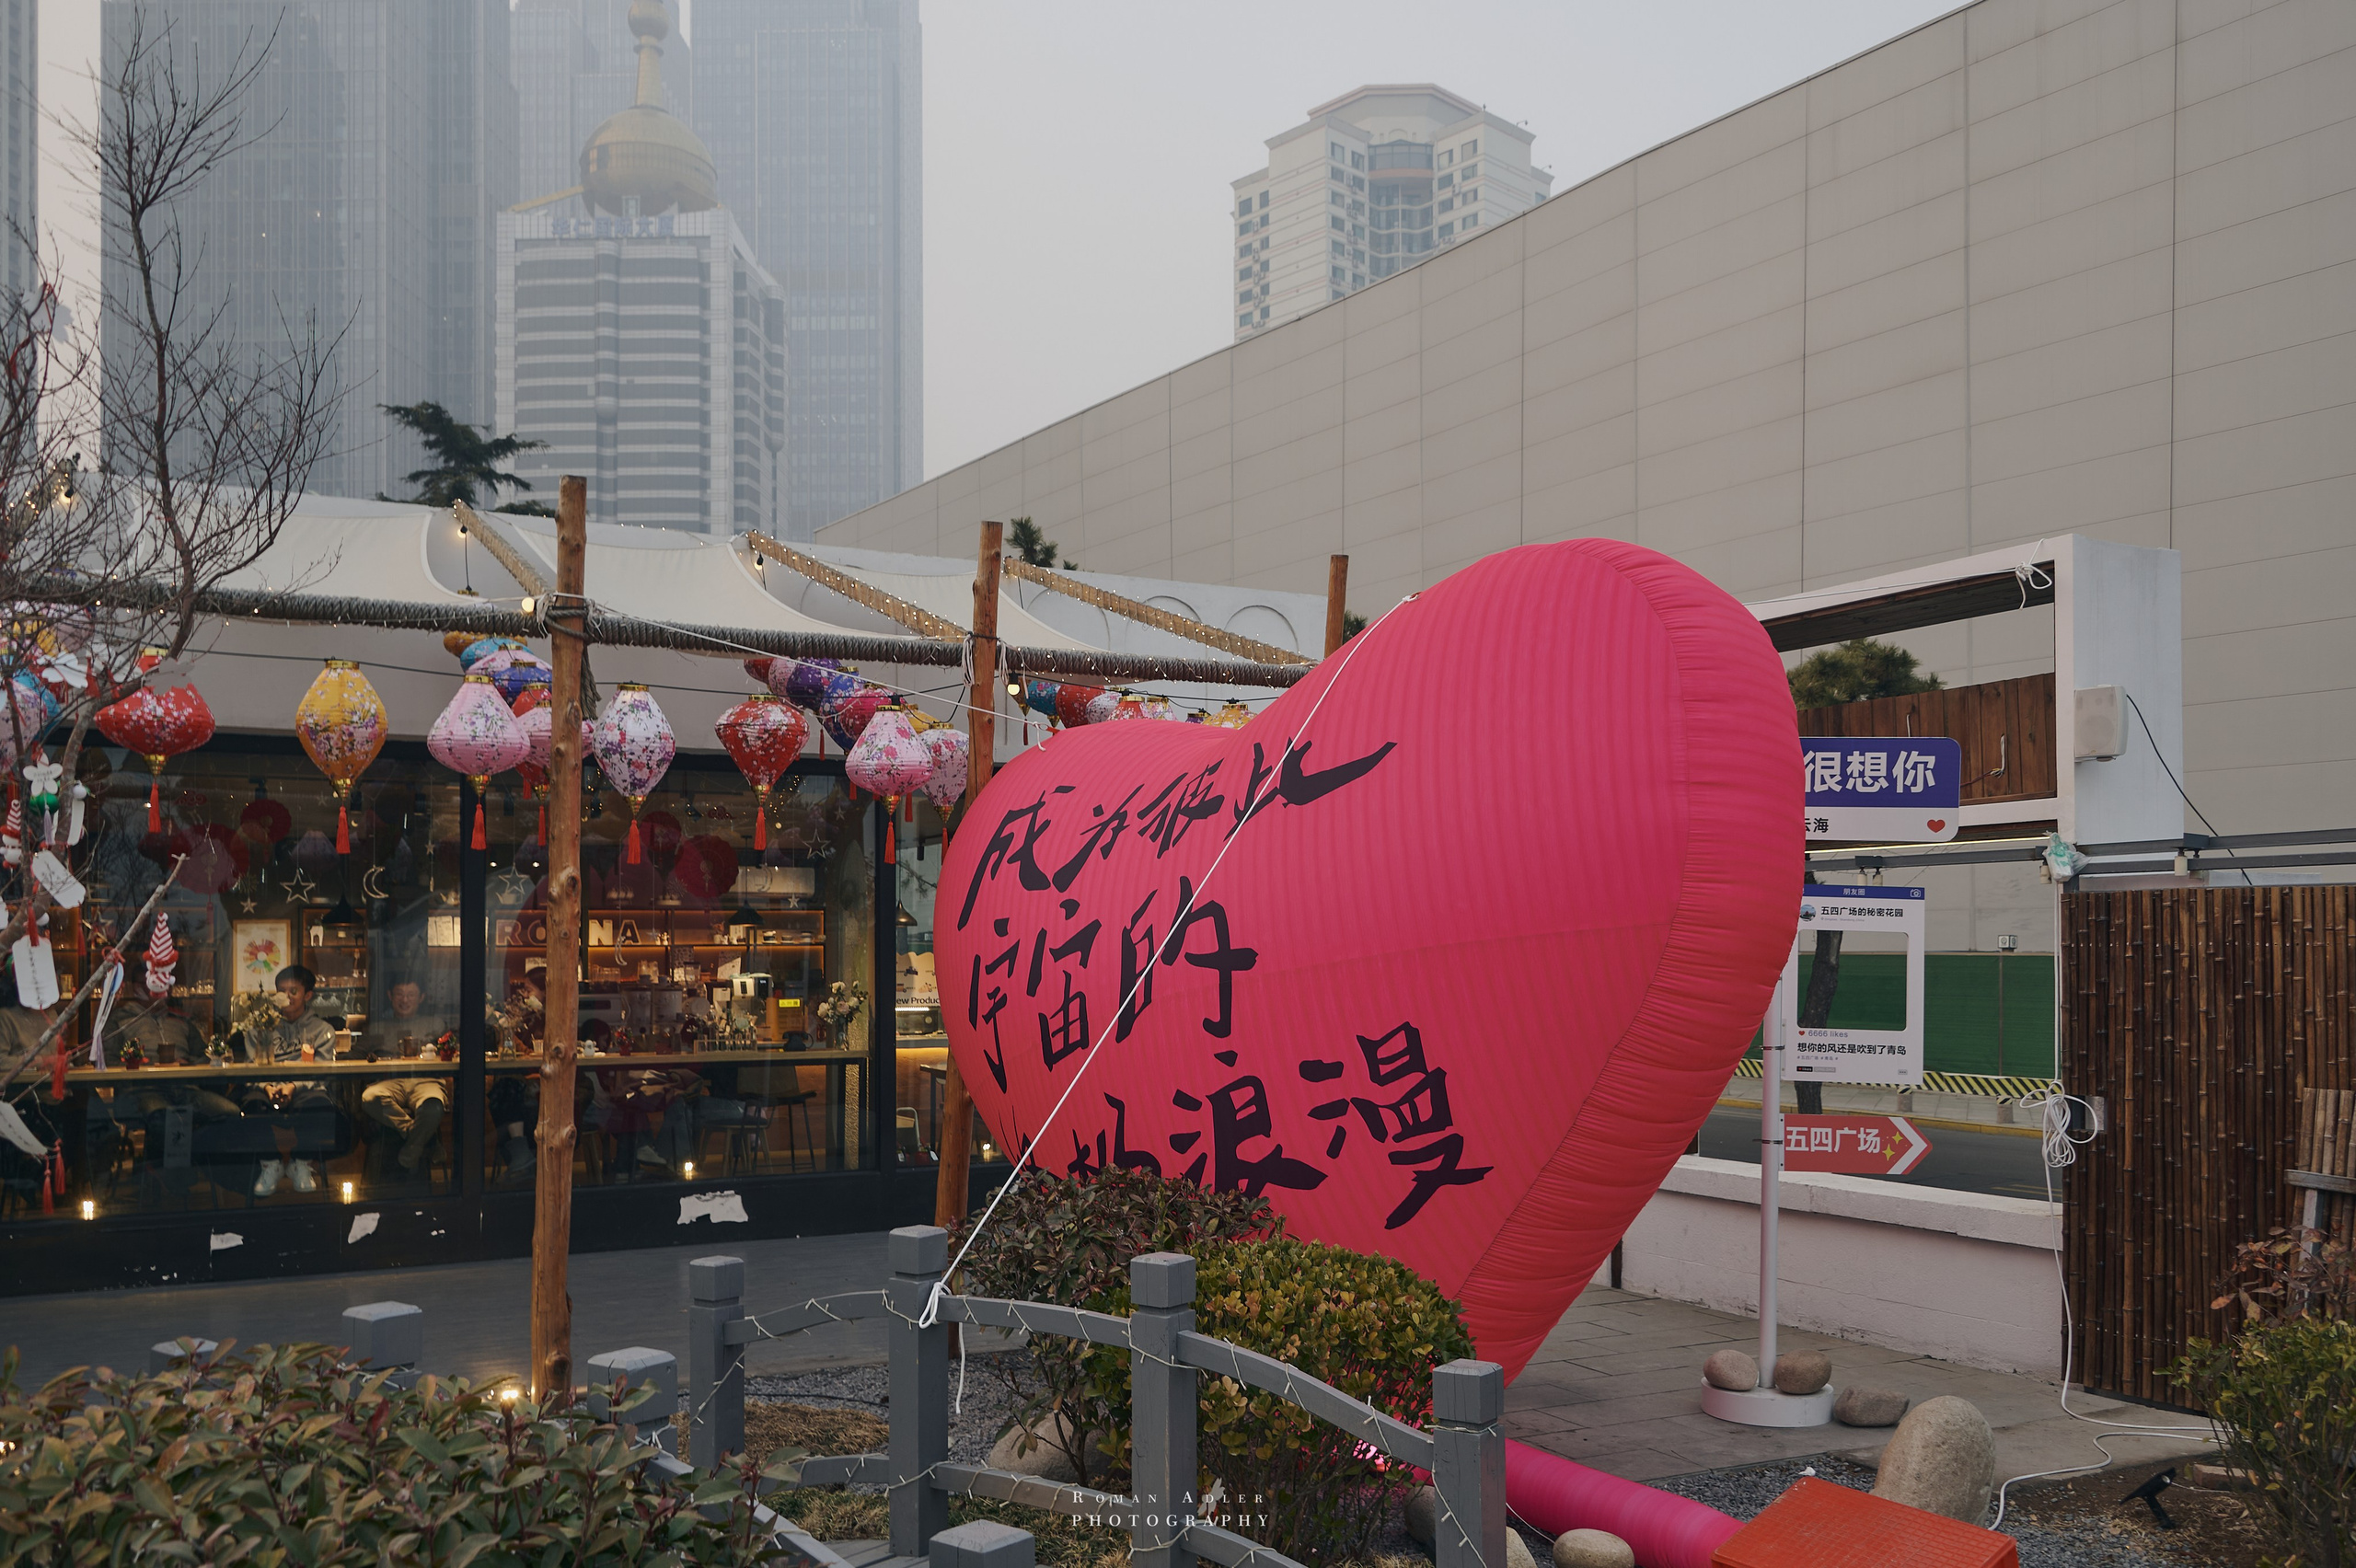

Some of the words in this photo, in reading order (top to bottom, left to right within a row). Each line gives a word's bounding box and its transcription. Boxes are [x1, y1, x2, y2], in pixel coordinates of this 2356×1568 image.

[1804, 751, 1935, 793] 很想你
[1842, 888, 1865, 896] 朋友圈
[1820, 905, 1903, 917] 五四广场的秘密花园
[495, 919, 642, 946] RONA
[969, 876, 1259, 1094] 宇宙的
[1797, 1043, 1907, 1055] 想你的风还是吹到了青岛
[999, 1021, 1494, 1230] 浪漫
[1785, 1126, 1881, 1154] 五四广场
